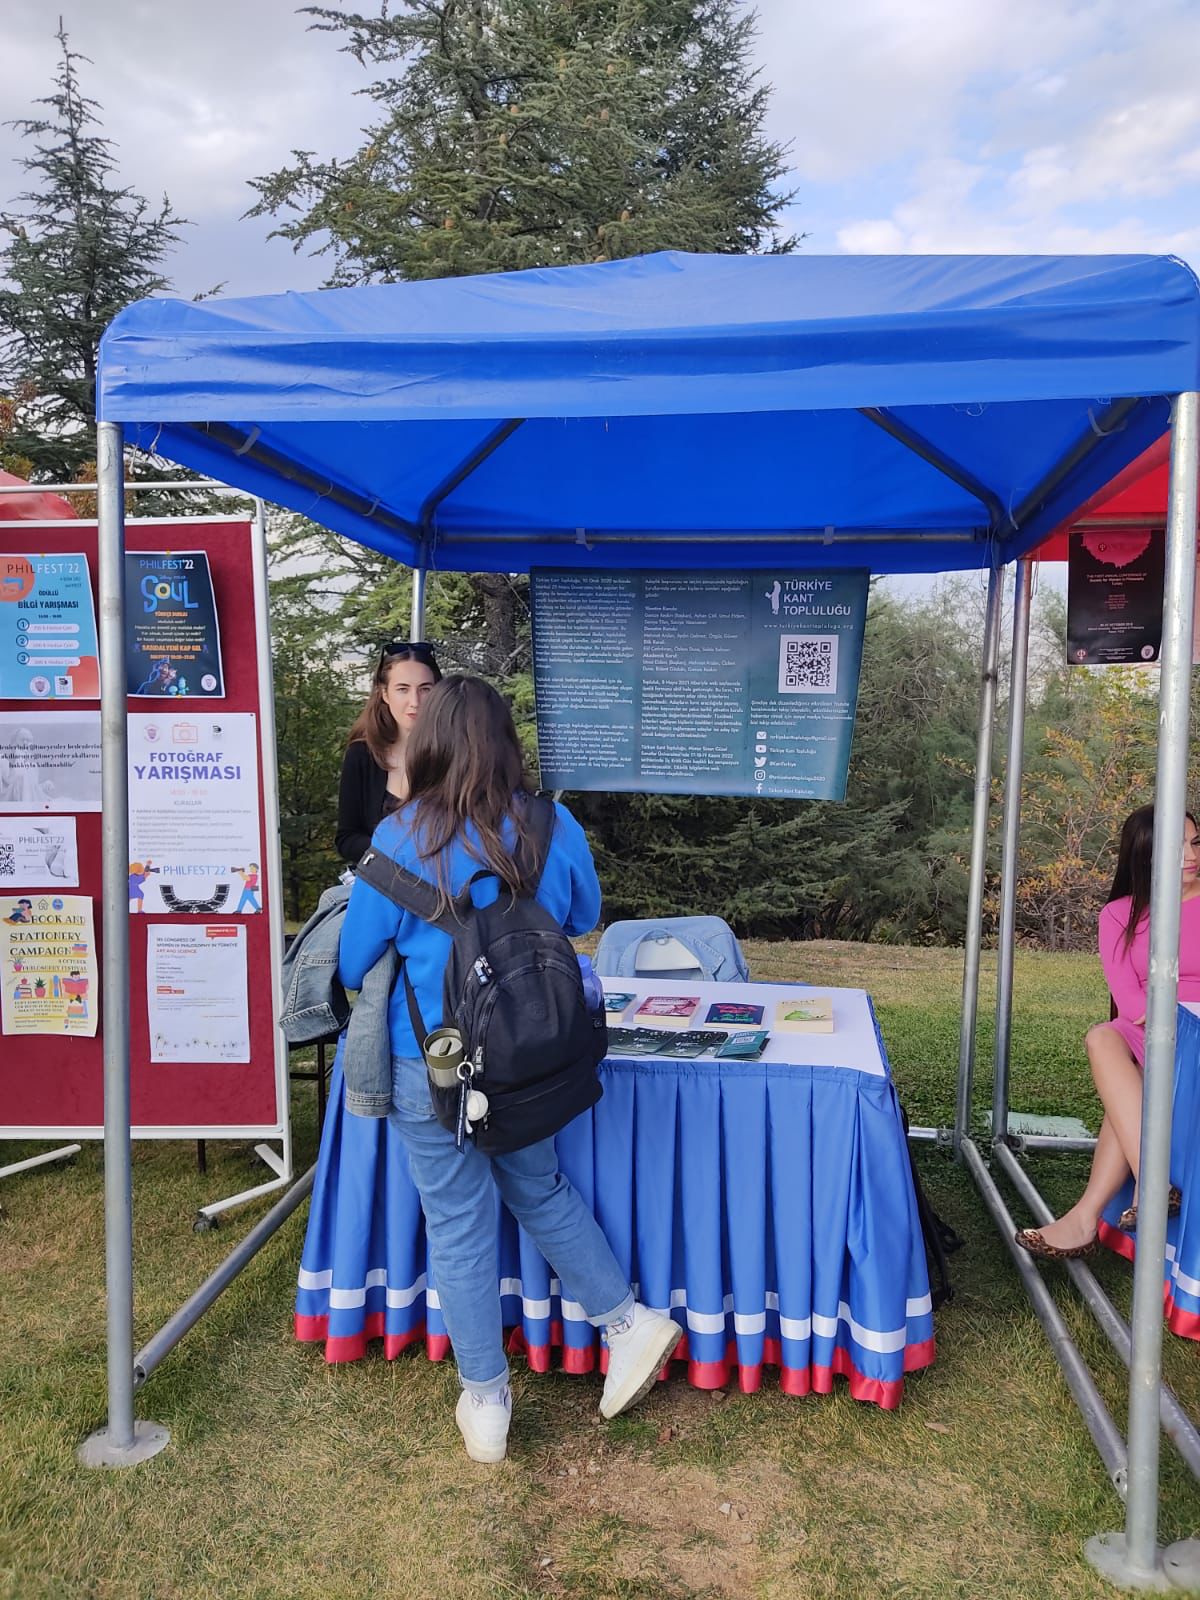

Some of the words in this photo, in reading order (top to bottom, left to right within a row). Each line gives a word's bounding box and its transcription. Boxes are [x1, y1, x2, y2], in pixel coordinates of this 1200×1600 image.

[7, 563, 79, 574] PHILFEST'22
[139, 559, 194, 569] PHILFEST'22
[784, 579, 832, 590] TÜRKİYE
[141, 575, 199, 613] SOUL
[783, 593, 814, 602] KANT
[18, 600, 38, 608] BİLGİ
[39, 600, 79, 610] YARIŞMASI
[783, 603, 851, 615] TOPLULUĞU
[150, 749, 223, 763] FOTOĞRAF
[134, 766, 241, 783] YARIŞMASI
[19, 836, 64, 844] PHILFEST'22
[163, 865, 226, 875] PHILFEST'22
[31, 914, 62, 924] BOOK
[10, 932, 80, 941] STATIONERY
[10, 947, 72, 956] CAMPAIGN
